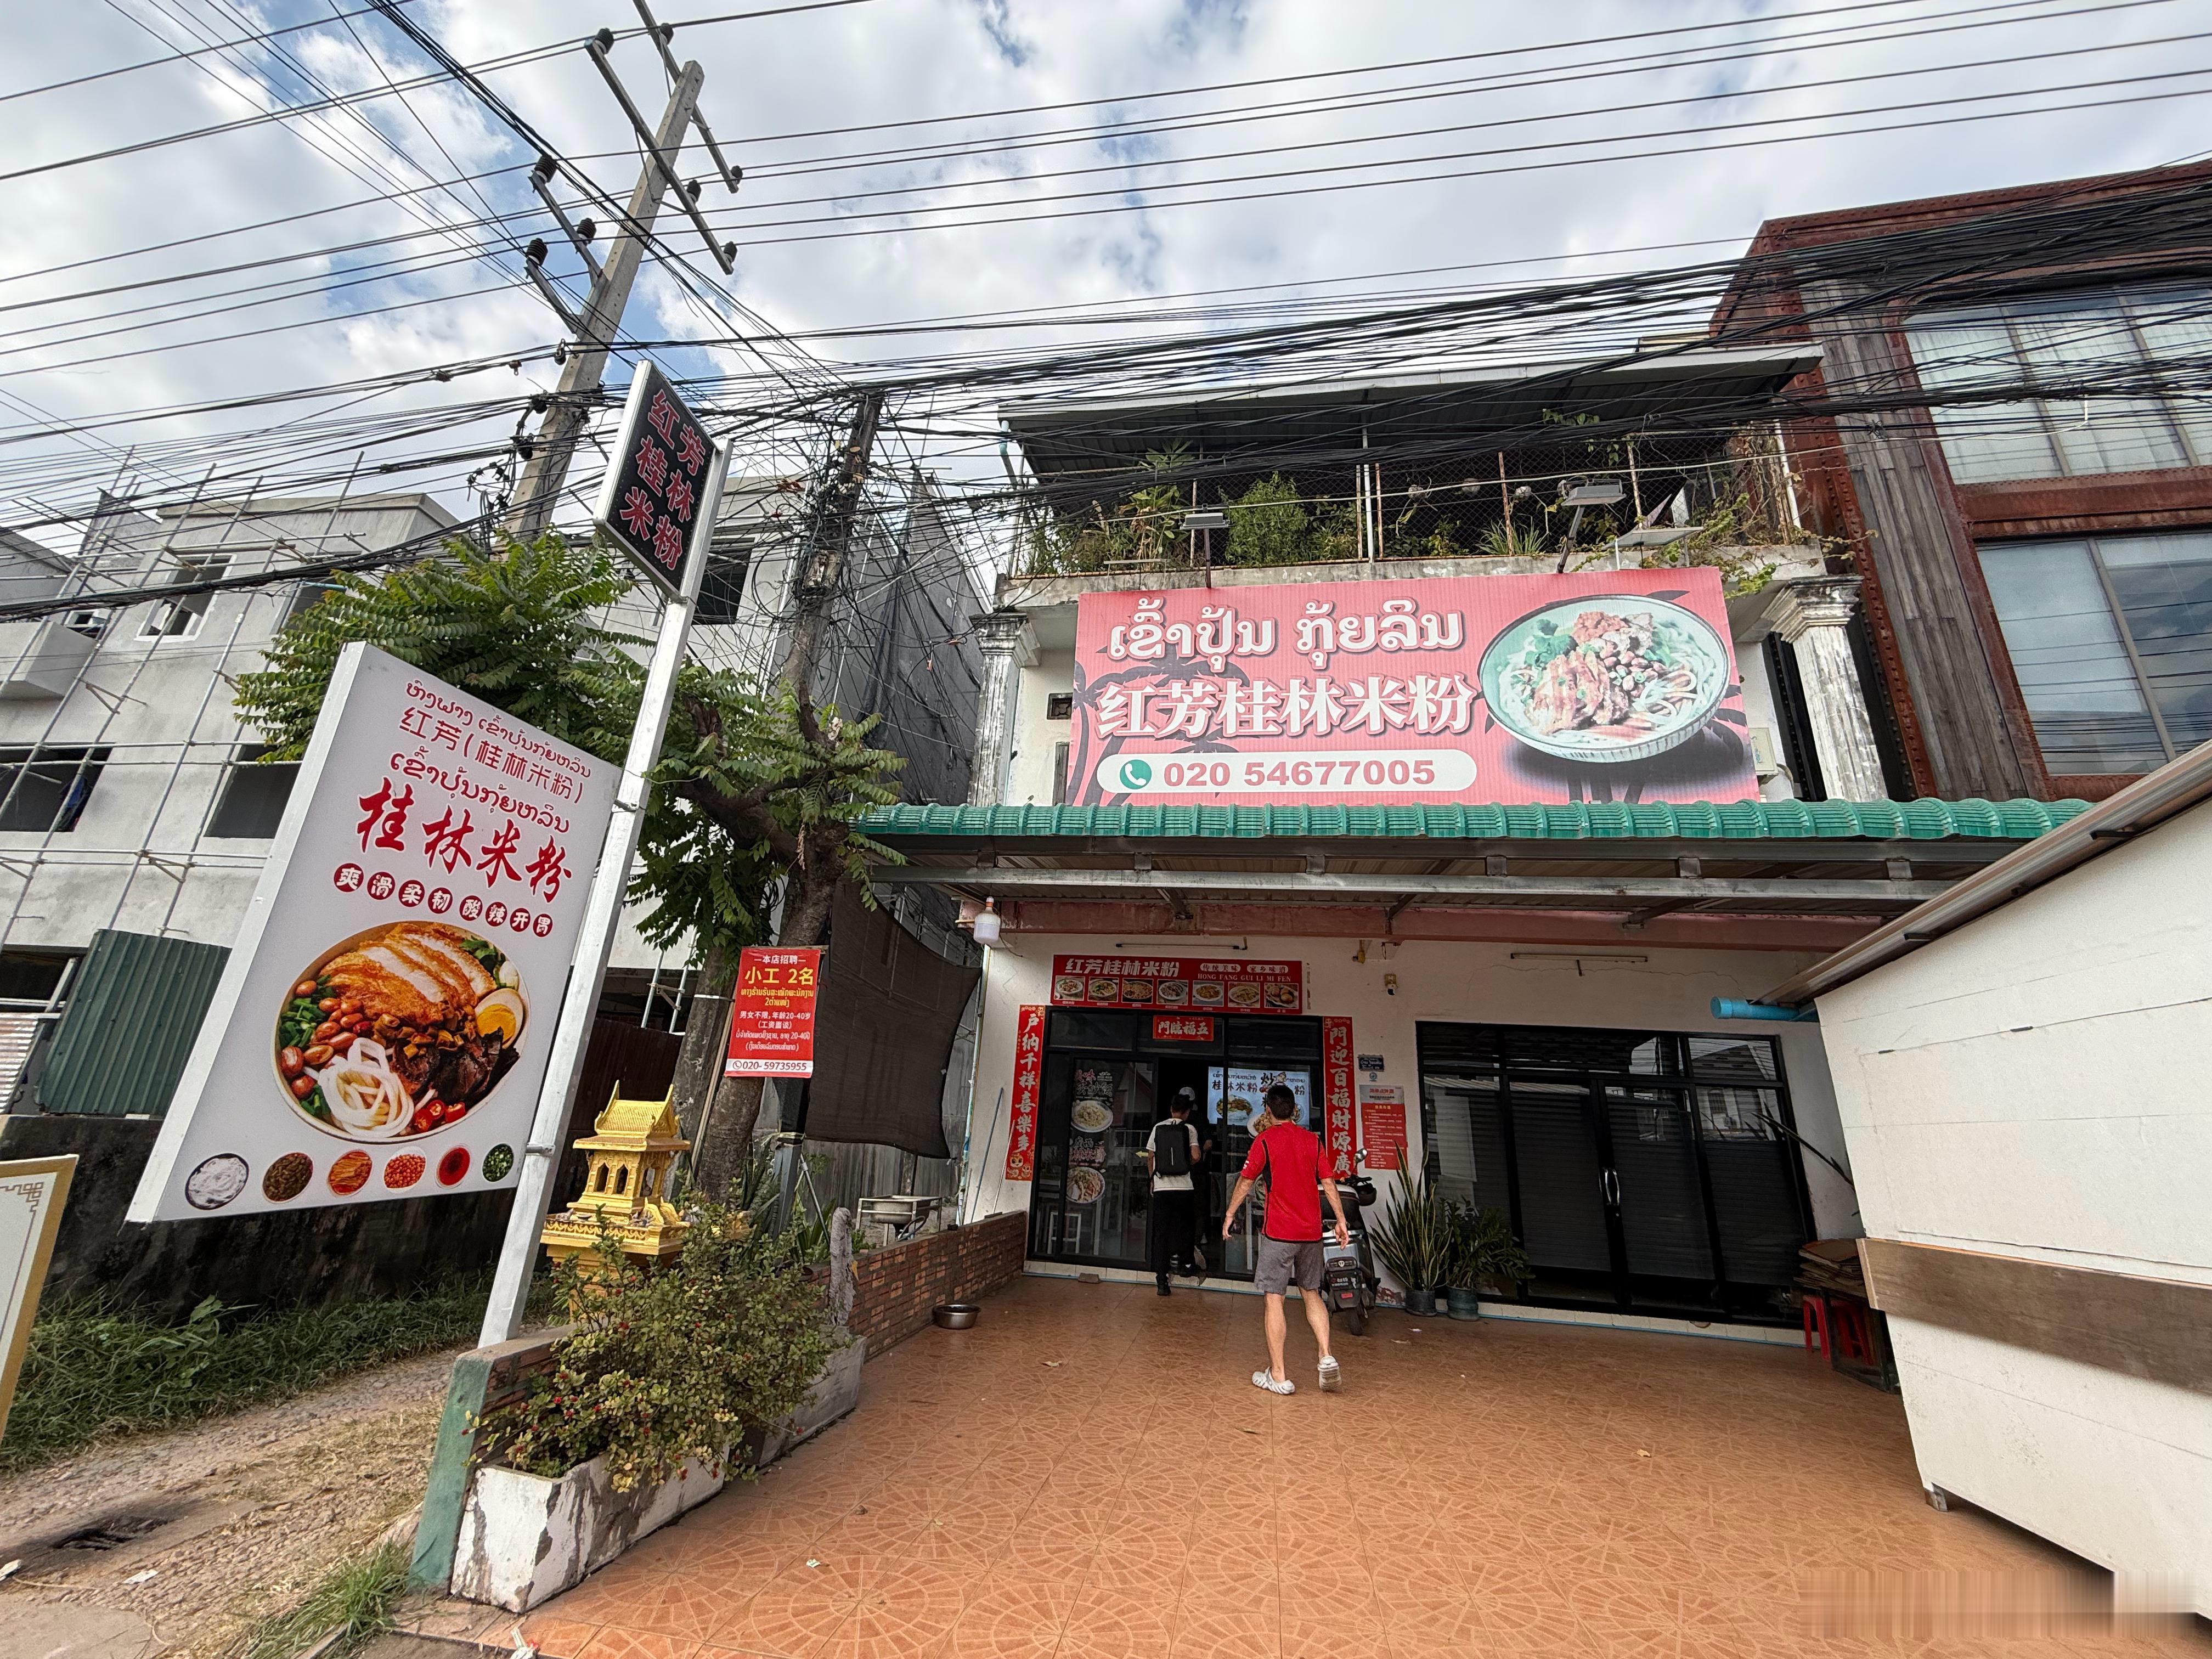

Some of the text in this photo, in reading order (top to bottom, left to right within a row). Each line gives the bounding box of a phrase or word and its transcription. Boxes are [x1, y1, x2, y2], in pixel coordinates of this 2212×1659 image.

[648, 389, 706, 476] 红芳
[636, 435, 695, 523] 桂林
[620, 487, 683, 571] 米粉
[1110, 597, 1273, 670] ເຂົ້າປຸ້ນ
[1097, 673, 1472, 736] 红芳桂林米粉
[1164, 759, 1436, 787] 020 54677005
[357, 777, 572, 904] 桂林米粉
[744, 967, 814, 986] 小工 2名
[1065, 958, 1180, 978] 红芳桂林米粉
